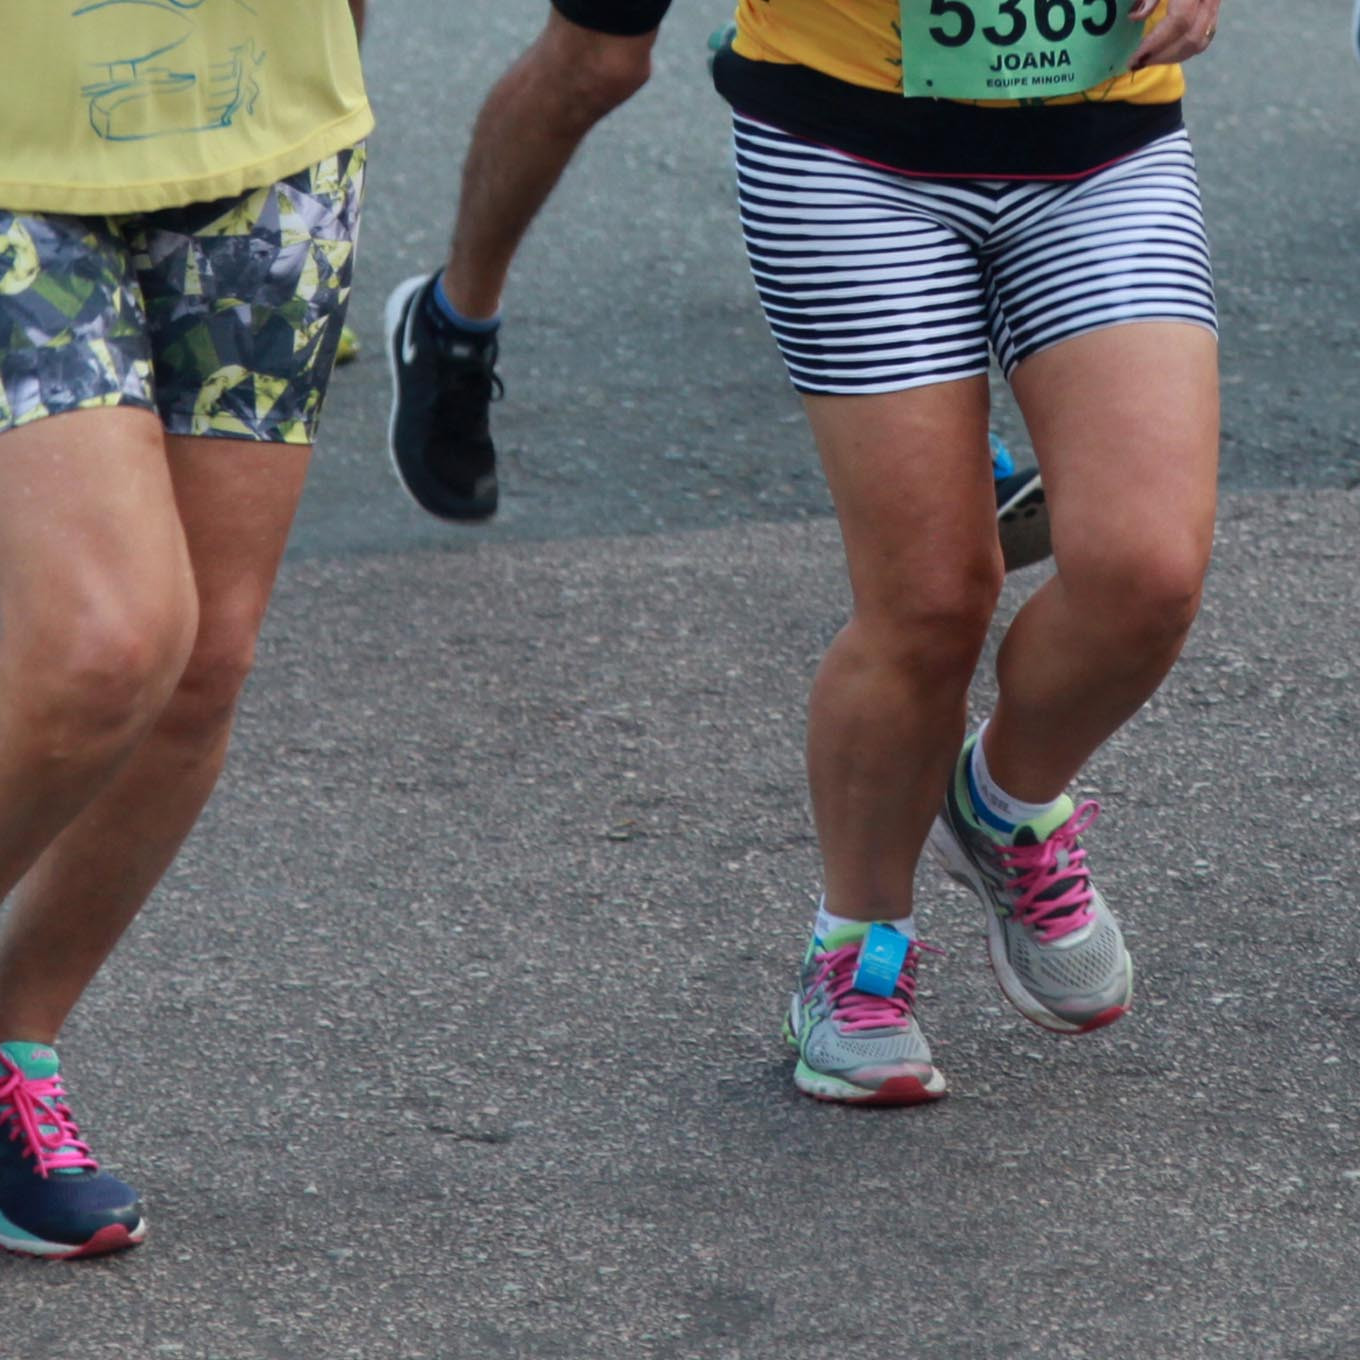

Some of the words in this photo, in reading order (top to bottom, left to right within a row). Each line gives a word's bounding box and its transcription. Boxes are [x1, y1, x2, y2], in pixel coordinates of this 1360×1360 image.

[990, 48, 1072, 72] JOANA
[986, 77, 1028, 89] EQUIPE
[1031, 73, 1076, 87] MINORU
